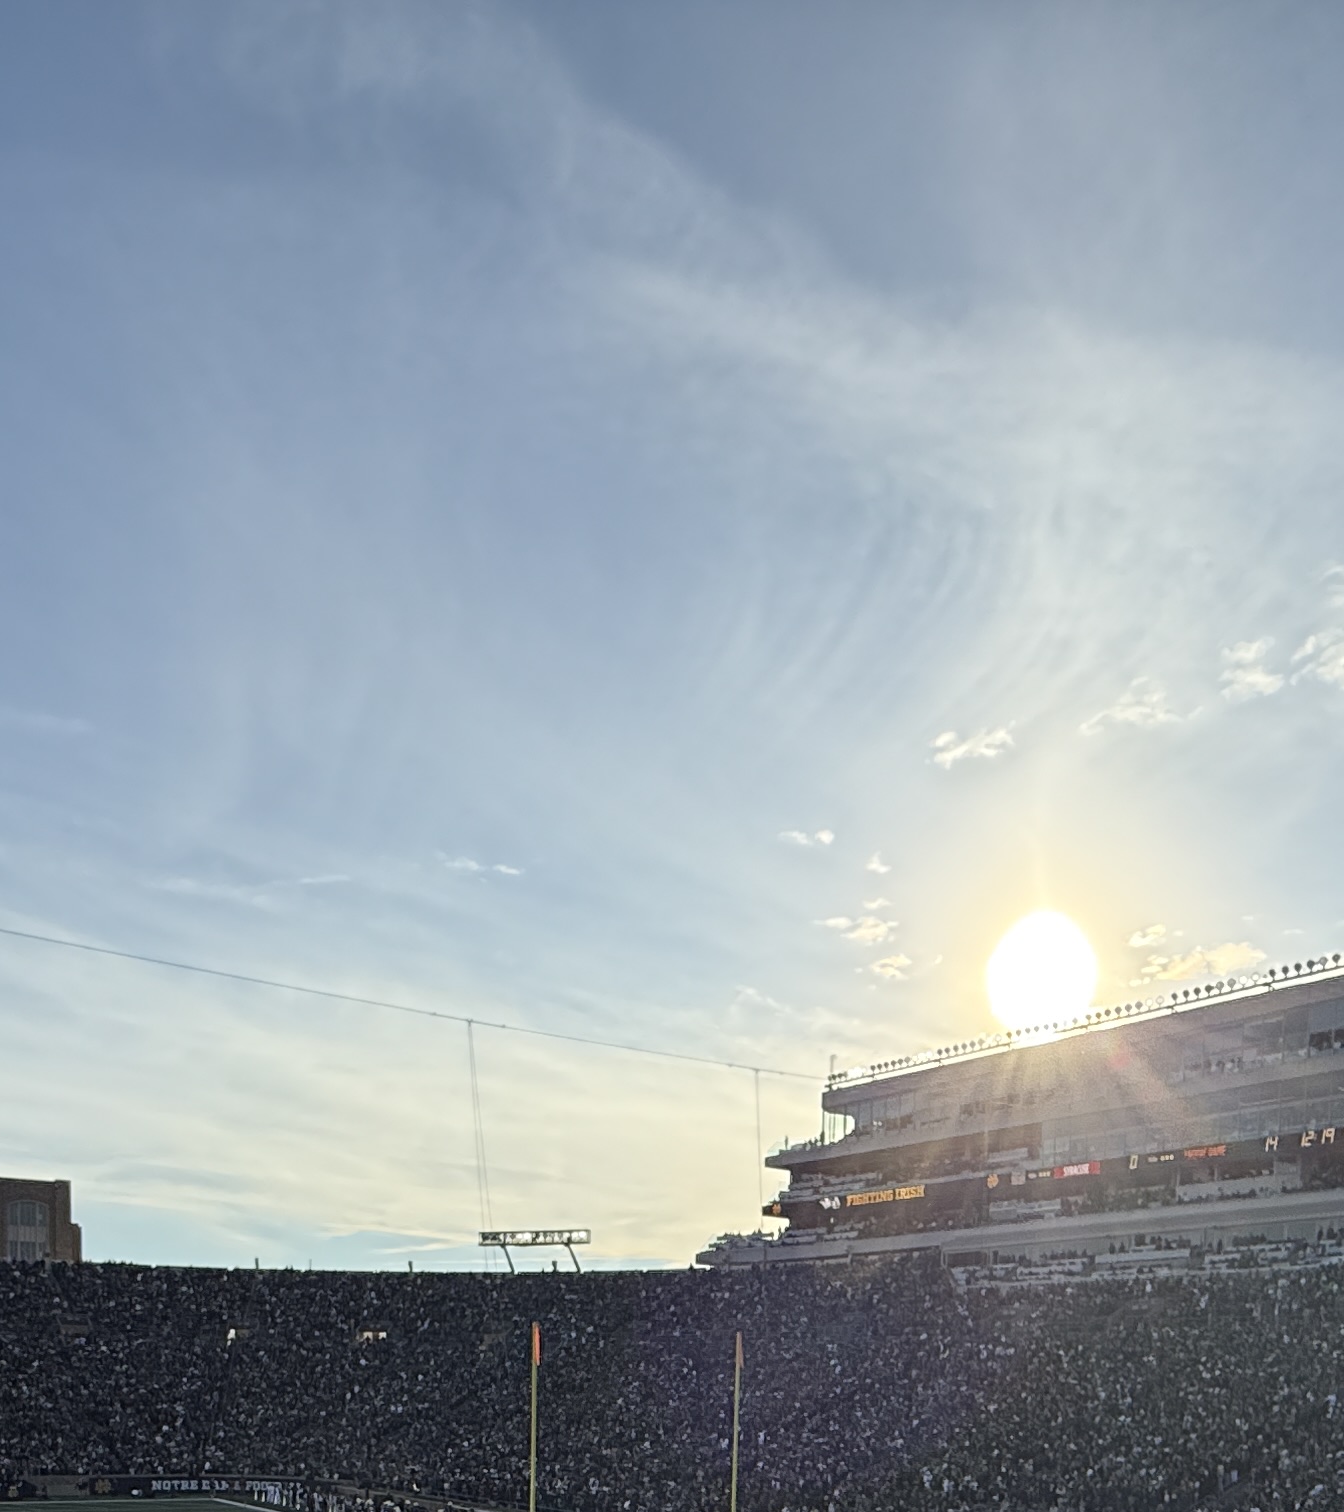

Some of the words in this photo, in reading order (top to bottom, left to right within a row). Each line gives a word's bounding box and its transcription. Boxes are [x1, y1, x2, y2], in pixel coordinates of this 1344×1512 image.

[1265, 1135, 1278, 1152] 14
[846, 1188, 894, 1207] FIGHTING
[895, 1185, 925, 1200] IRISH
[151, 1479, 199, 1491] NOTRE
